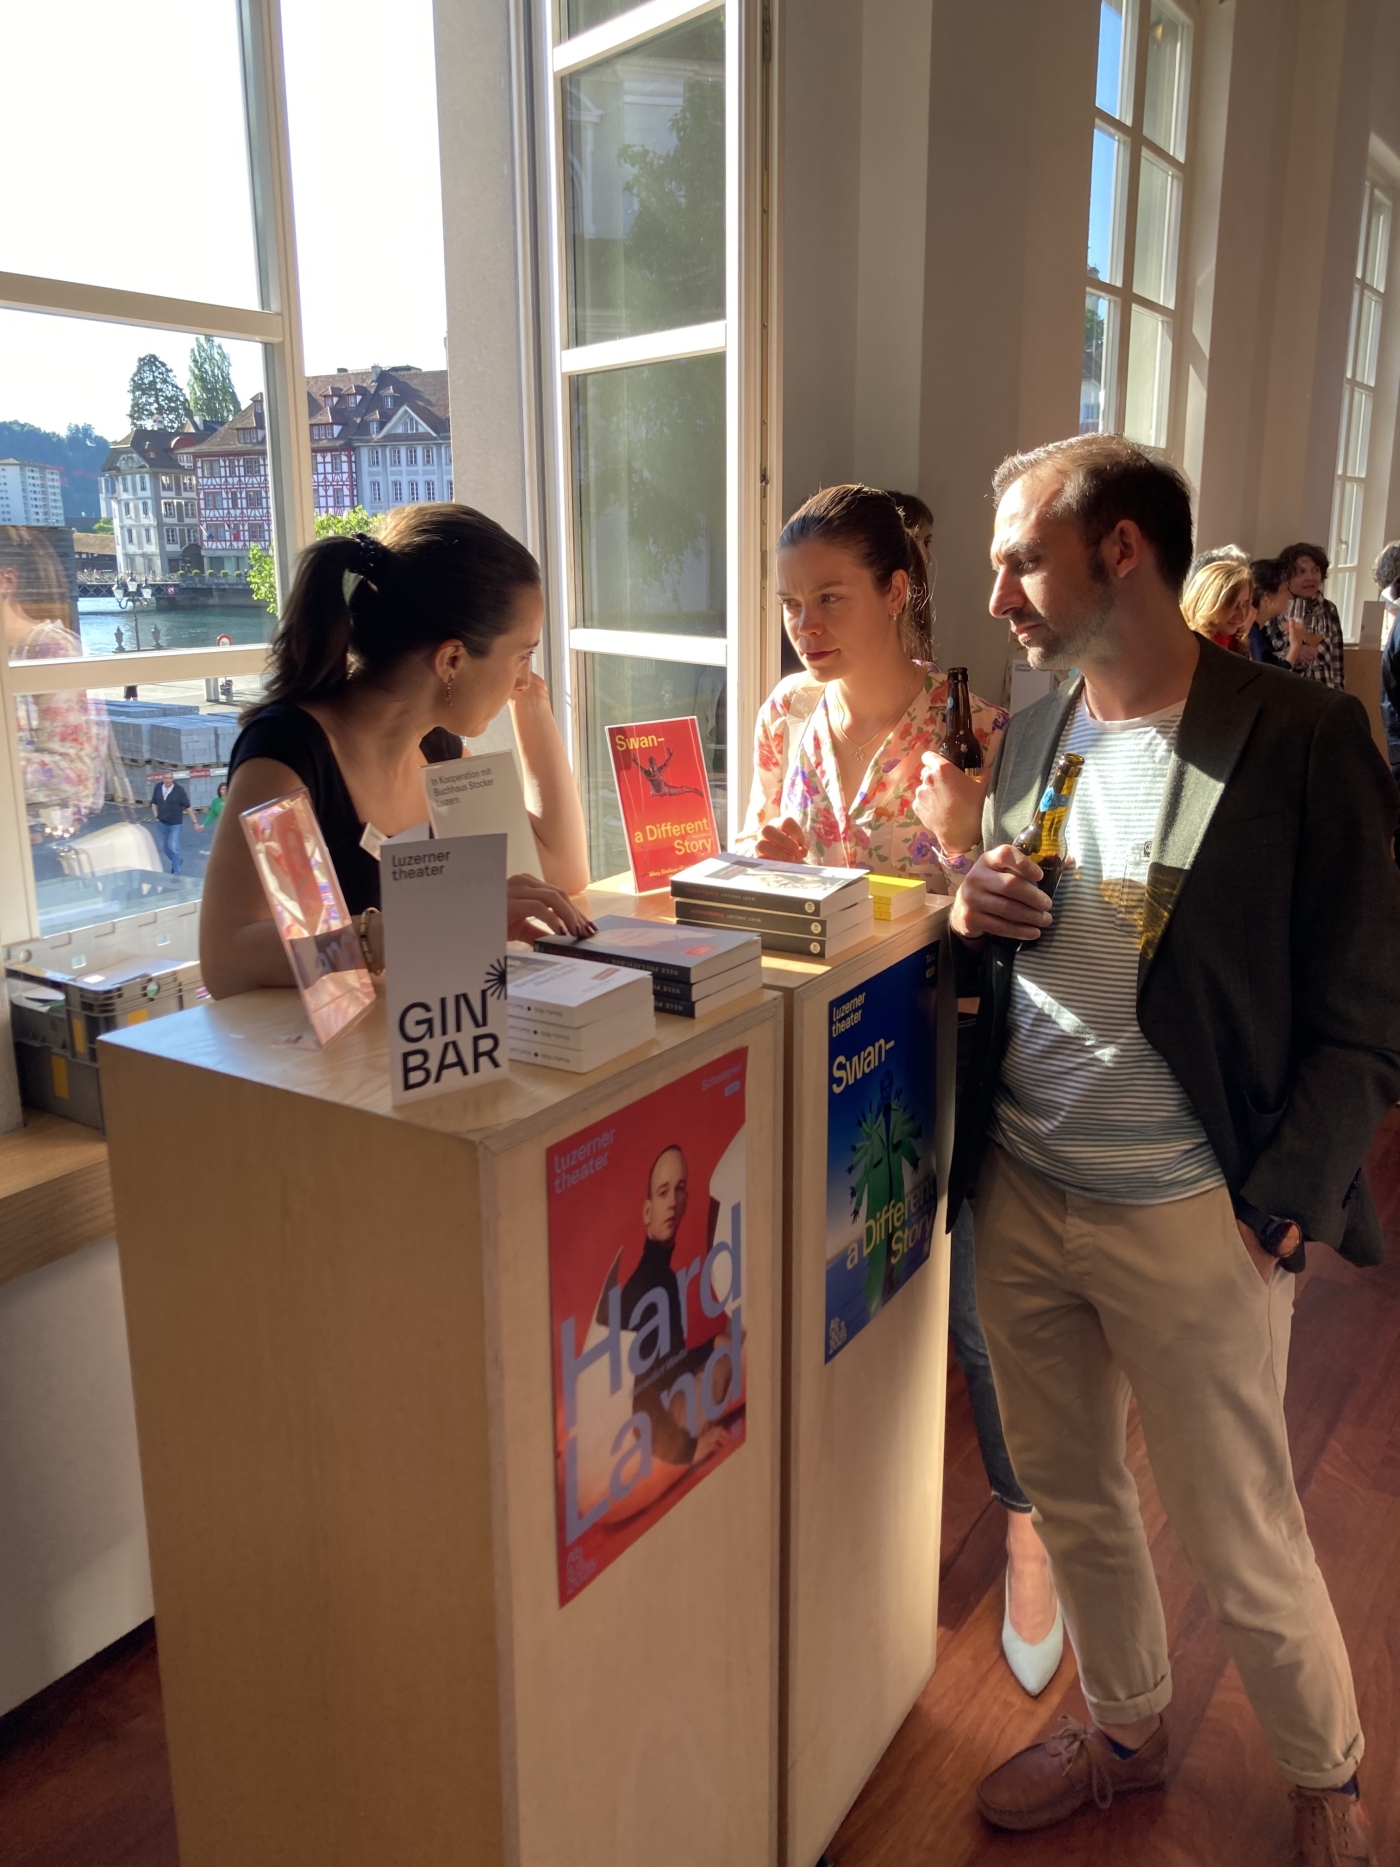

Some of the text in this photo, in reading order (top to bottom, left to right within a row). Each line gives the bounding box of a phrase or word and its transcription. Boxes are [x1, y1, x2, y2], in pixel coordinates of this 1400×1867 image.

[615, 734, 665, 751] Swan-
[431, 768, 492, 786] In Kooperation mit
[433, 778, 494, 797] Buchhaus Stocker
[436, 796, 460, 807] Luzern
[634, 831, 643, 843] a
[646, 817, 709, 841] Different
[391, 850, 451, 867] luzerner
[674, 837, 712, 856] Story
[391, 864, 445, 881] theater
[398, 989, 488, 1043] GIN
[832, 992, 866, 1022] luzerner
[831, 1009, 863, 1038] theater
[402, 1032, 501, 1091] BAR
[831, 1039, 895, 1095] Swan-
[554, 1127, 615, 1174] luzerner
[554, 1150, 610, 1194] theater
[846, 1174, 936, 1270] a Different
[890, 1207, 935, 1266] Story
[561, 1201, 742, 1430] Hard
[565, 1303, 742, 1547] Land
